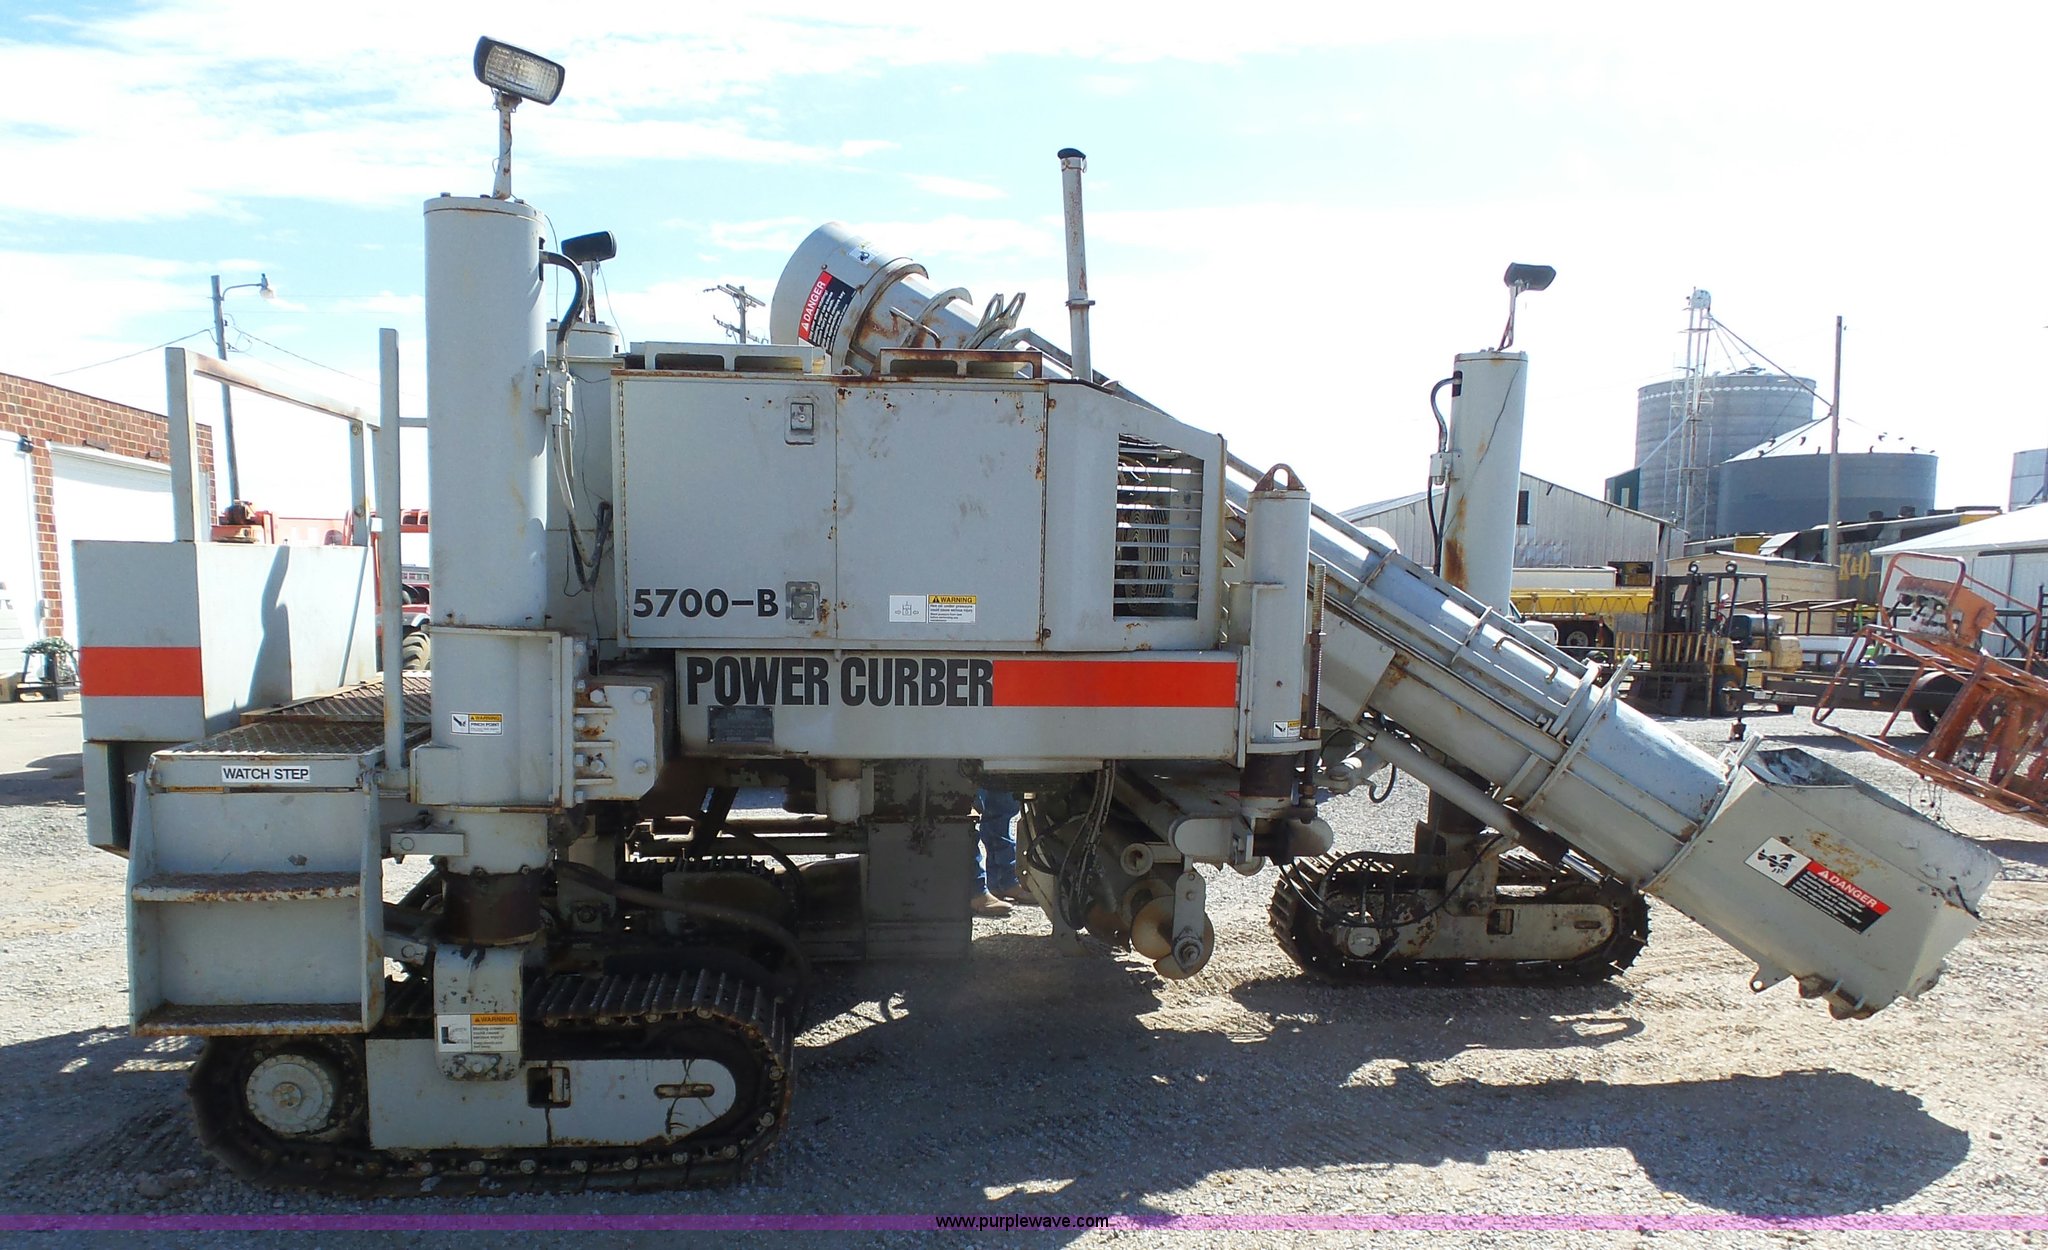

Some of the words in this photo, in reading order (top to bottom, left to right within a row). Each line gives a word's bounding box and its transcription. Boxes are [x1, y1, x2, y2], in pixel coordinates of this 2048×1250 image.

[803, 281, 826, 322] DANGER
[633, 588, 779, 618] 5700-B
[687, 656, 829, 706] POWER
[841, 657, 993, 706] CURBER
[223, 768, 270, 780] WATCH
[274, 768, 309, 780] STEP
[1829, 875, 1877, 908] DANGER
